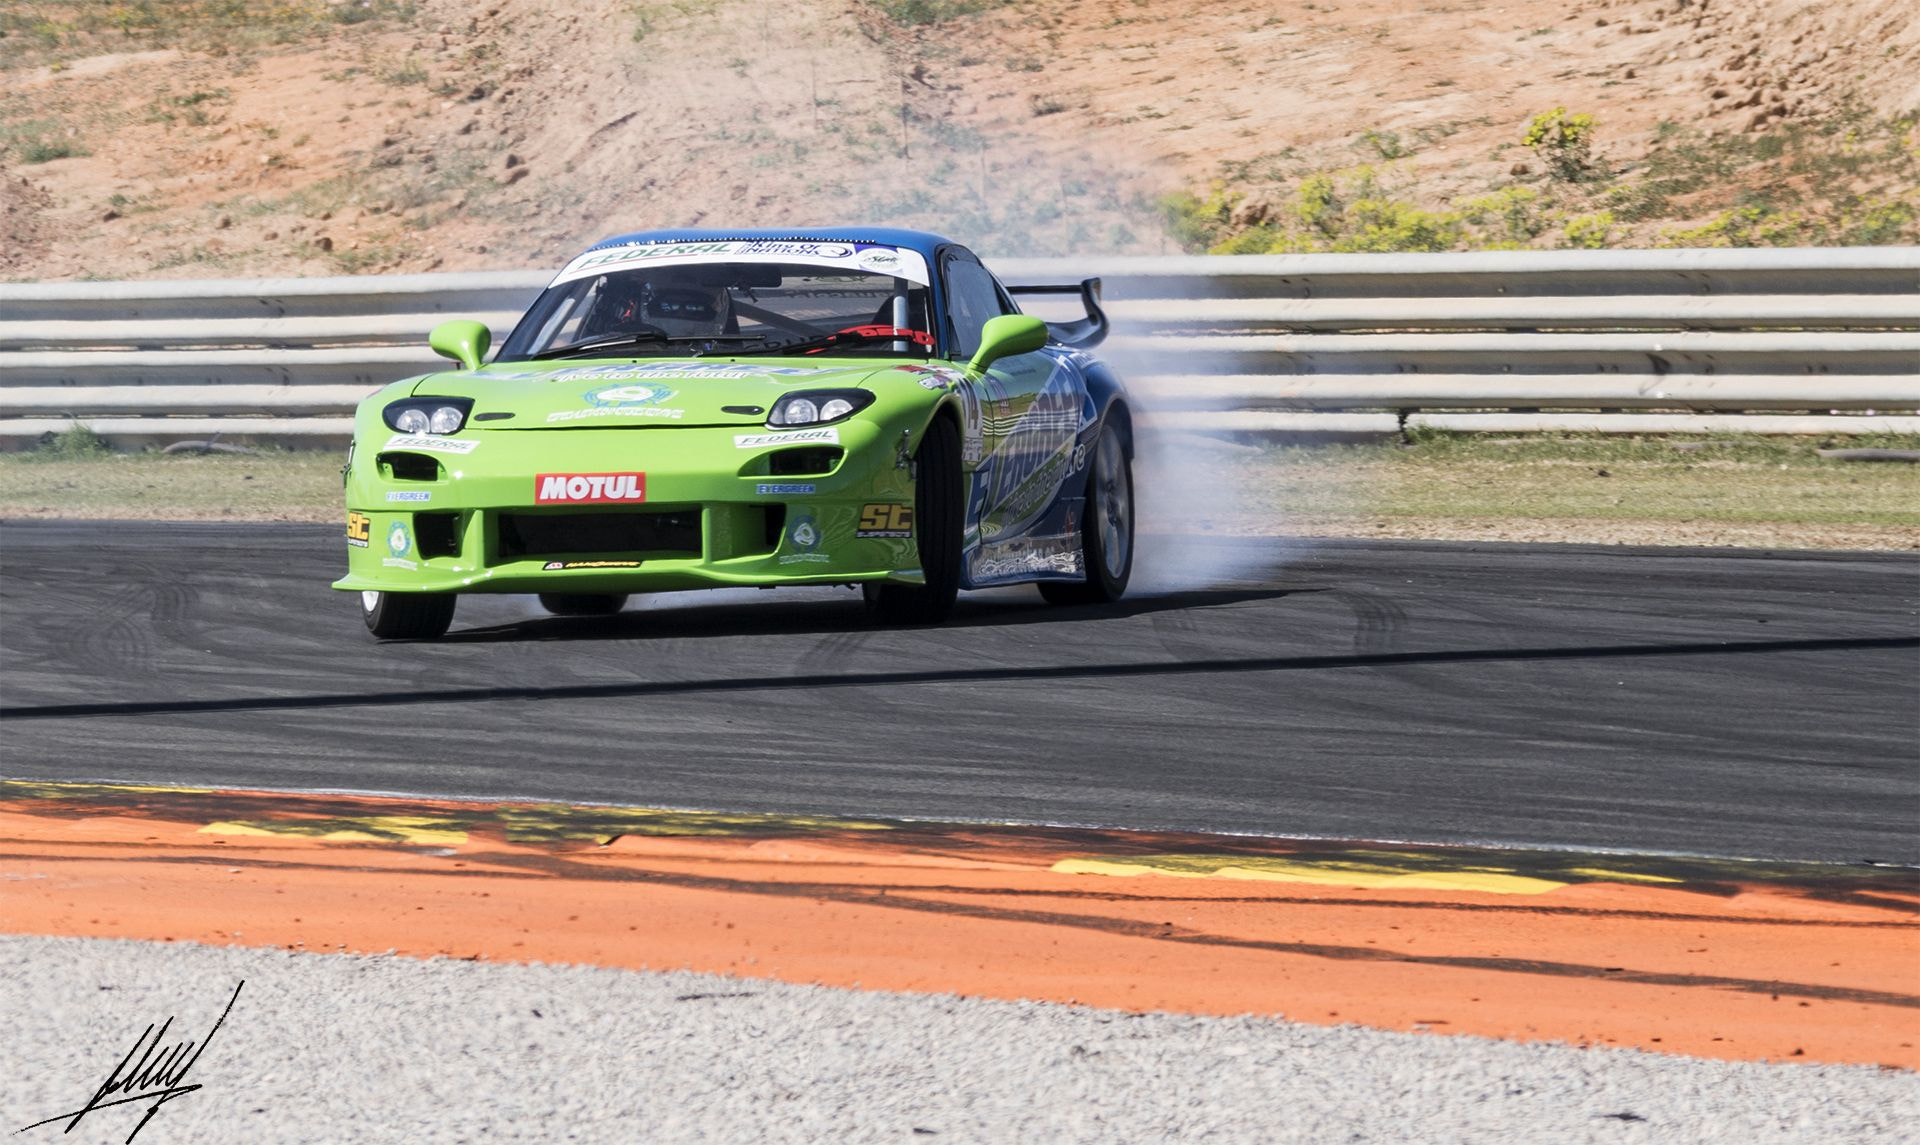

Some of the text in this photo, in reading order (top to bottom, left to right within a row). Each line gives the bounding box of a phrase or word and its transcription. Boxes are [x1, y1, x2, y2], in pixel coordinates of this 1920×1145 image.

[577, 243, 732, 269] FEDERAL
[741, 430, 833, 444] FEDERAL
[539, 475, 642, 500] MOTUL
